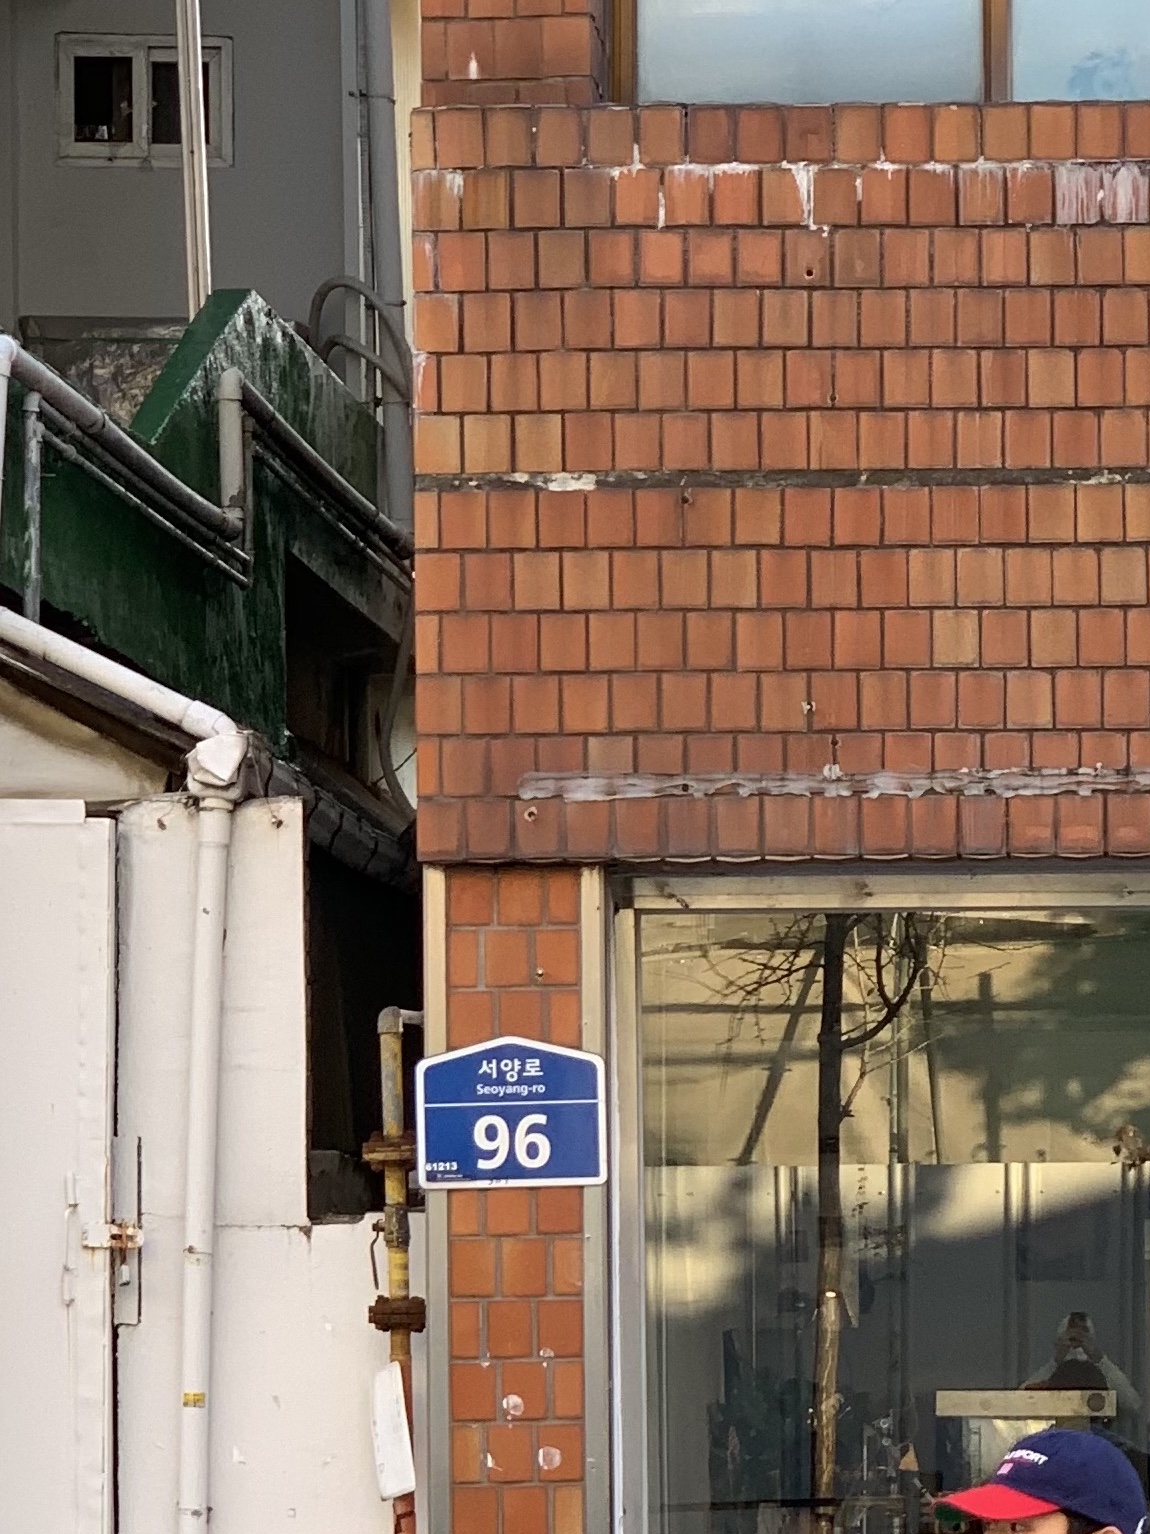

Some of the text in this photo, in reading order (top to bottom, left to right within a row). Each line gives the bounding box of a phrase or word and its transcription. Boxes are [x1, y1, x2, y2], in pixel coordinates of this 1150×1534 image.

[478, 1058, 544, 1082] 서양로
[476, 1083, 546, 1097] Seoyang-ro
[473, 1113, 551, 1170] 96
[425, 1161, 458, 1171] 61213
